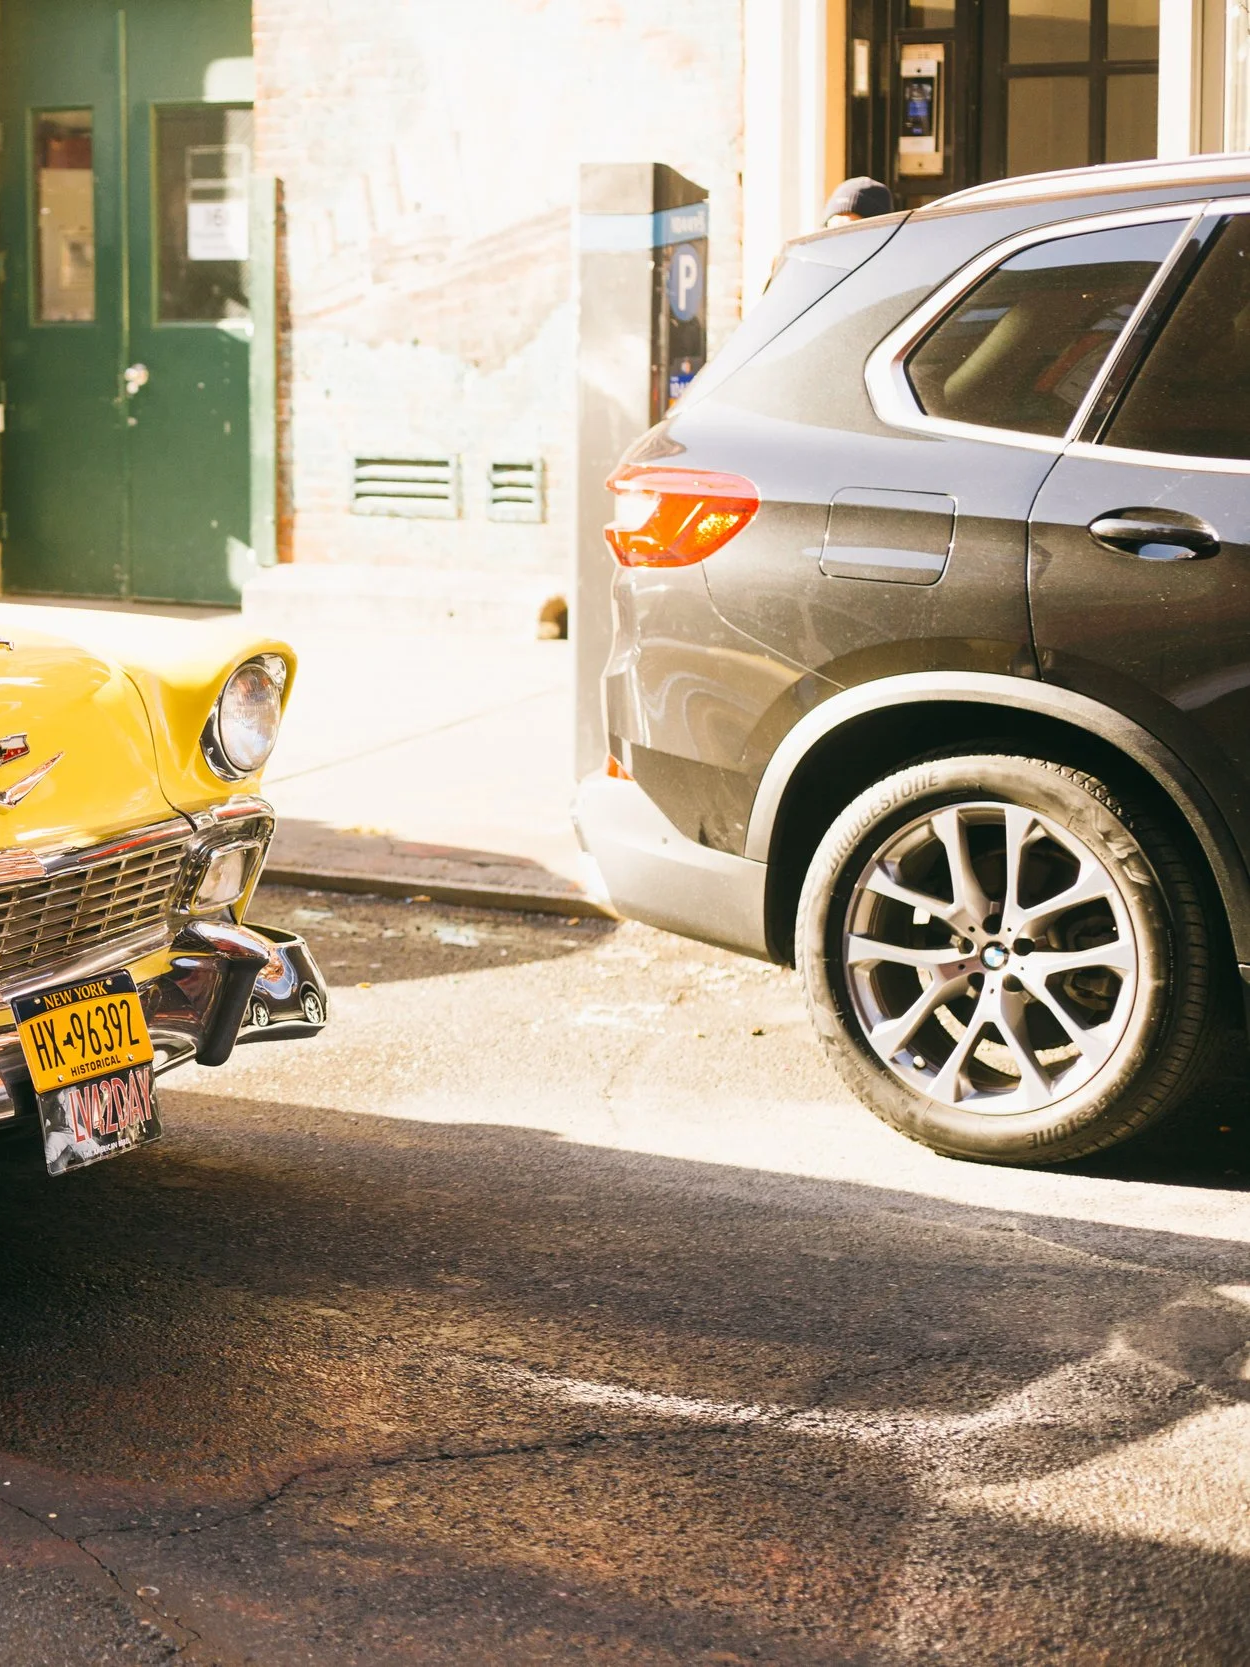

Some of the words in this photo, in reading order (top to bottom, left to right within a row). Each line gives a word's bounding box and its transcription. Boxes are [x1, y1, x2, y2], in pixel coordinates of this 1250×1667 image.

[678, 254, 698, 312] P
[830, 770, 940, 876] BRIDGESTONE
[43, 987, 75, 1010] NEW
[74, 981, 108, 1003] YORK
[69, 999, 140, 1059] 96392
[70, 1054, 121, 1077] HISTORICAL
